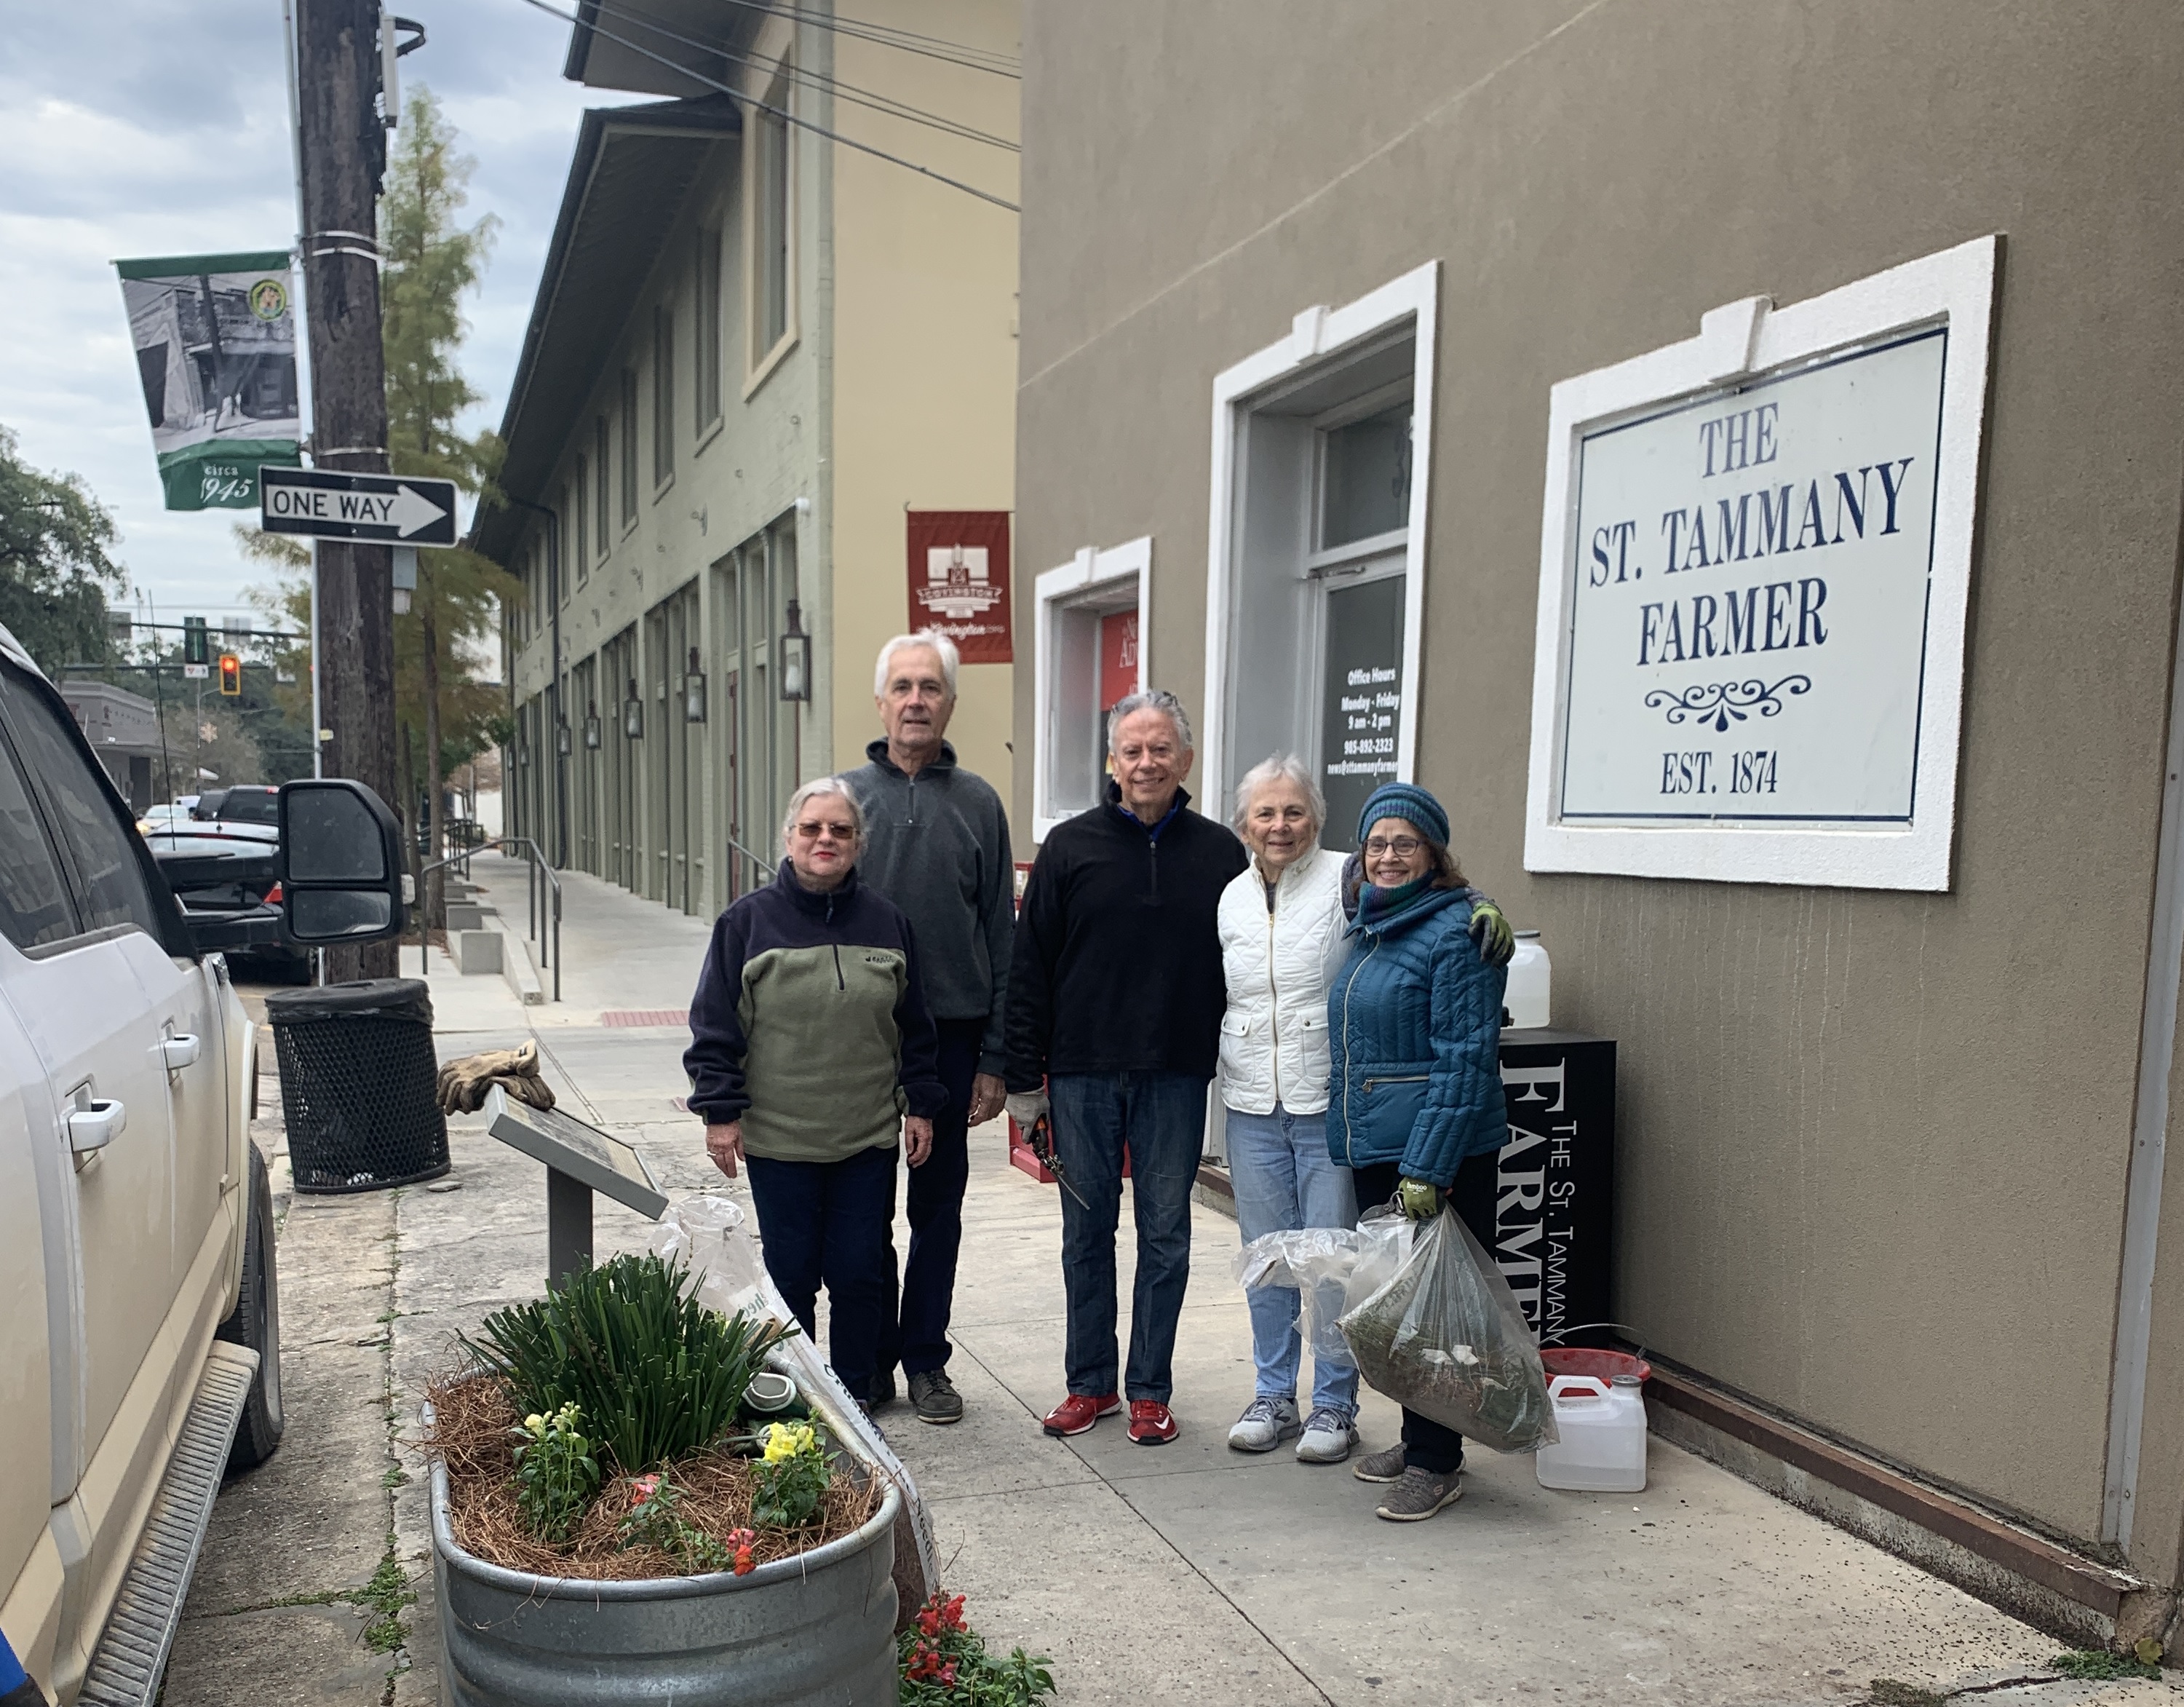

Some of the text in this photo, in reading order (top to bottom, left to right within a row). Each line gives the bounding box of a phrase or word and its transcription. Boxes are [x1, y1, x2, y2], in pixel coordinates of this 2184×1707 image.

[1699, 402, 1779, 478] THE
[204, 464, 239, 475] circa
[200, 478, 253, 503] 1945
[273, 490, 394, 522] ONE WAY
[1589, 458, 1914, 588] ST. TAMMANY
[1637, 577, 1829, 666] FARMER
[1348, 668, 1396, 686] Office Hours
[1341, 694, 1371, 713] Monday
[1376, 692, 1400, 710] Friday
[1349, 715, 1354, 730] 9
[1354, 717, 1367, 729] am
[1372, 713, 1377, 728] 2
[1378, 715, 1391, 731] pm
[1344, 737, 1394, 755] 985-892-2323
[1660, 752, 1778, 794] EST. 1874
